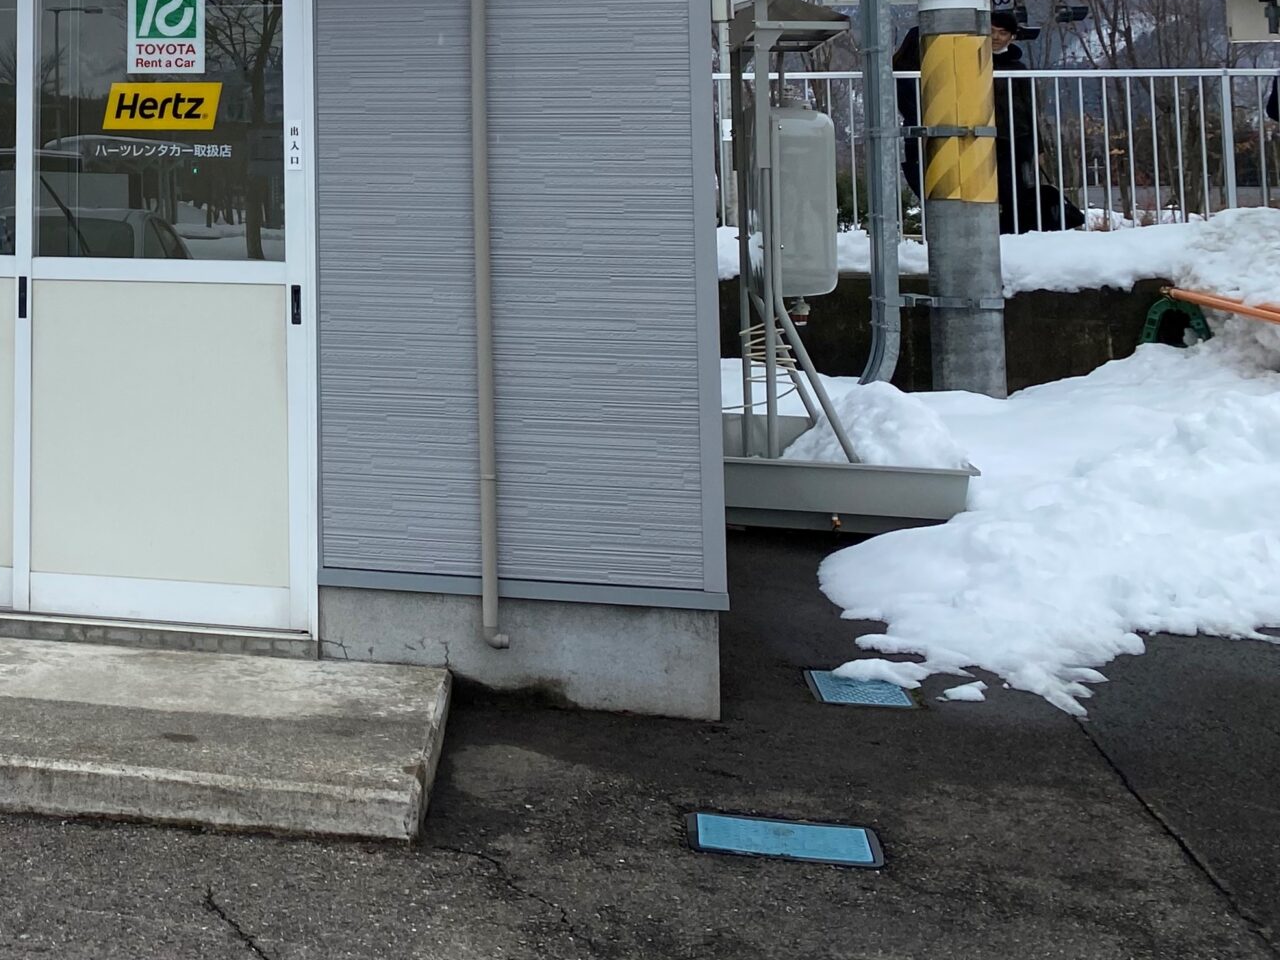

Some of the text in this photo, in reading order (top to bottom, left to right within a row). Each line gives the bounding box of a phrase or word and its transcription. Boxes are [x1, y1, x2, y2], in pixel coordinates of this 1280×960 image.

[136, 43, 196, 55] TOYOTA
[135, 57, 196, 68] Rent a Car
[115, 93, 205, 120] Hertz
[95, 144, 232, 158] ハーツレンタカー取扱店
[289, 126, 300, 165] 出入口
